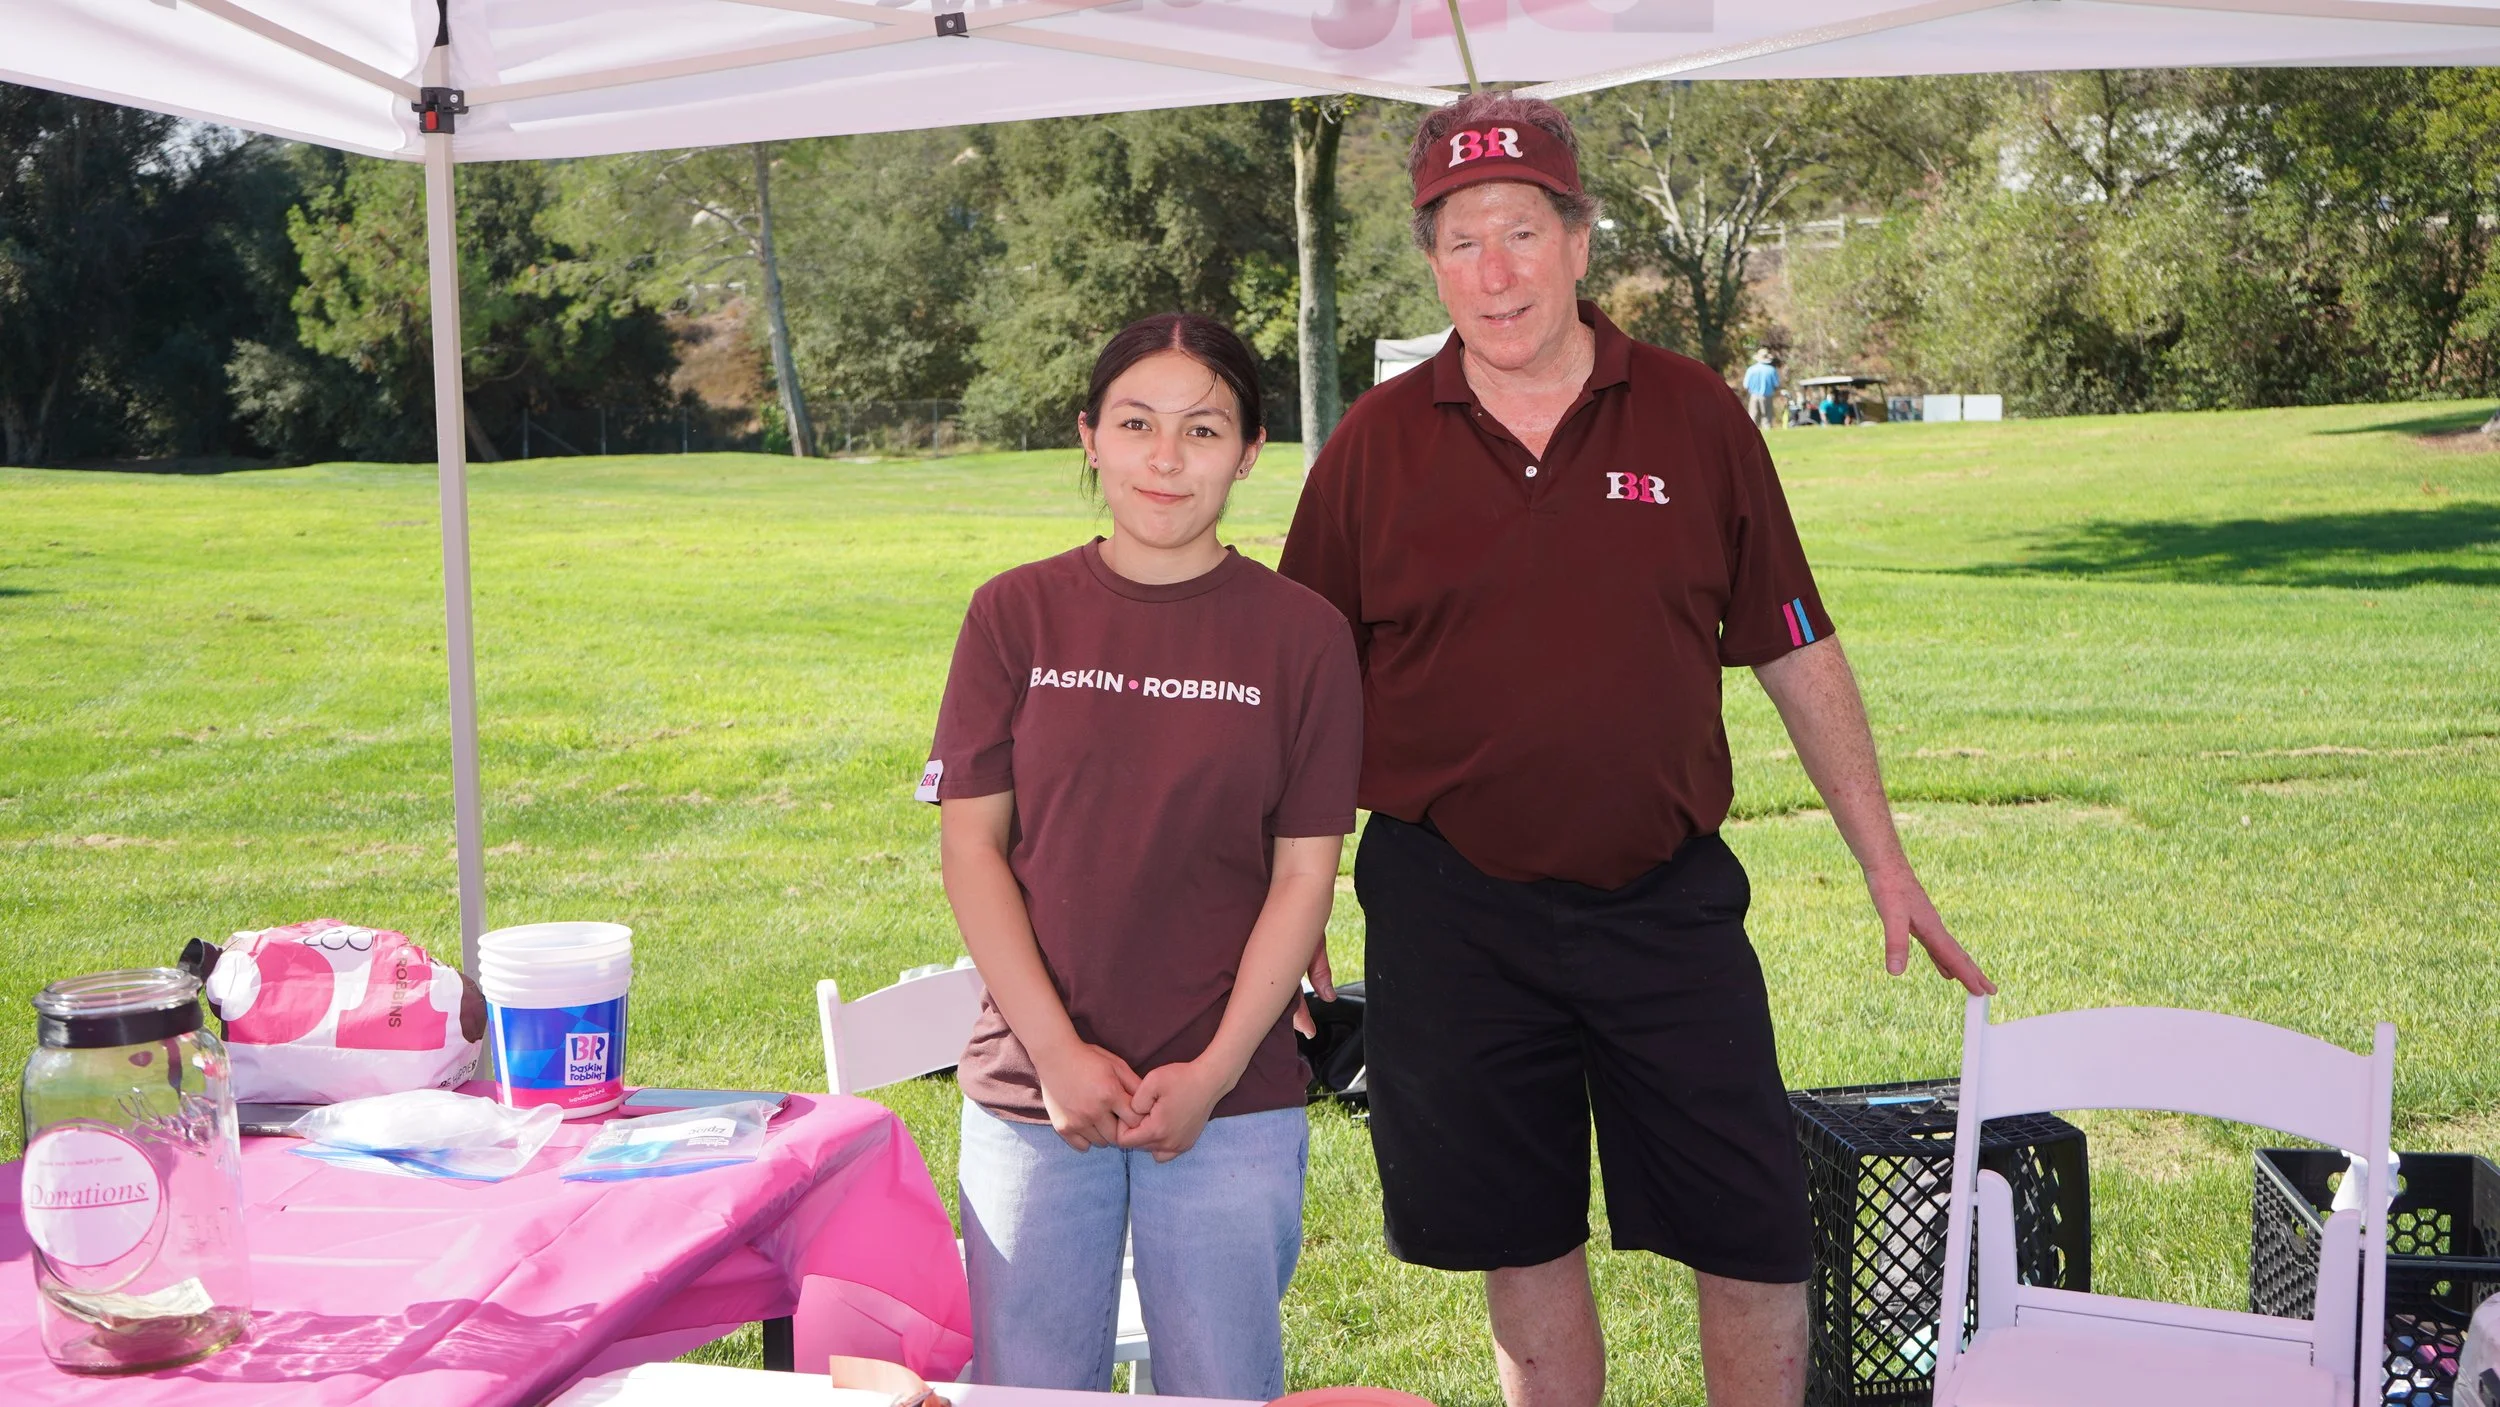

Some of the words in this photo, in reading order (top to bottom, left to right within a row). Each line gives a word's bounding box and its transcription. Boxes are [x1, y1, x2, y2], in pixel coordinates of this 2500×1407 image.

[1448, 127, 1523, 168] BR
[1606, 471, 1670, 504] BR
[1030, 667, 1124, 692] BASKIN
[1143, 677, 1261, 706] ROBBINS
[571, 1035, 606, 1061] BR
[570, 1063, 603, 1072] baskin
[30, 1182, 148, 1206] Donations
